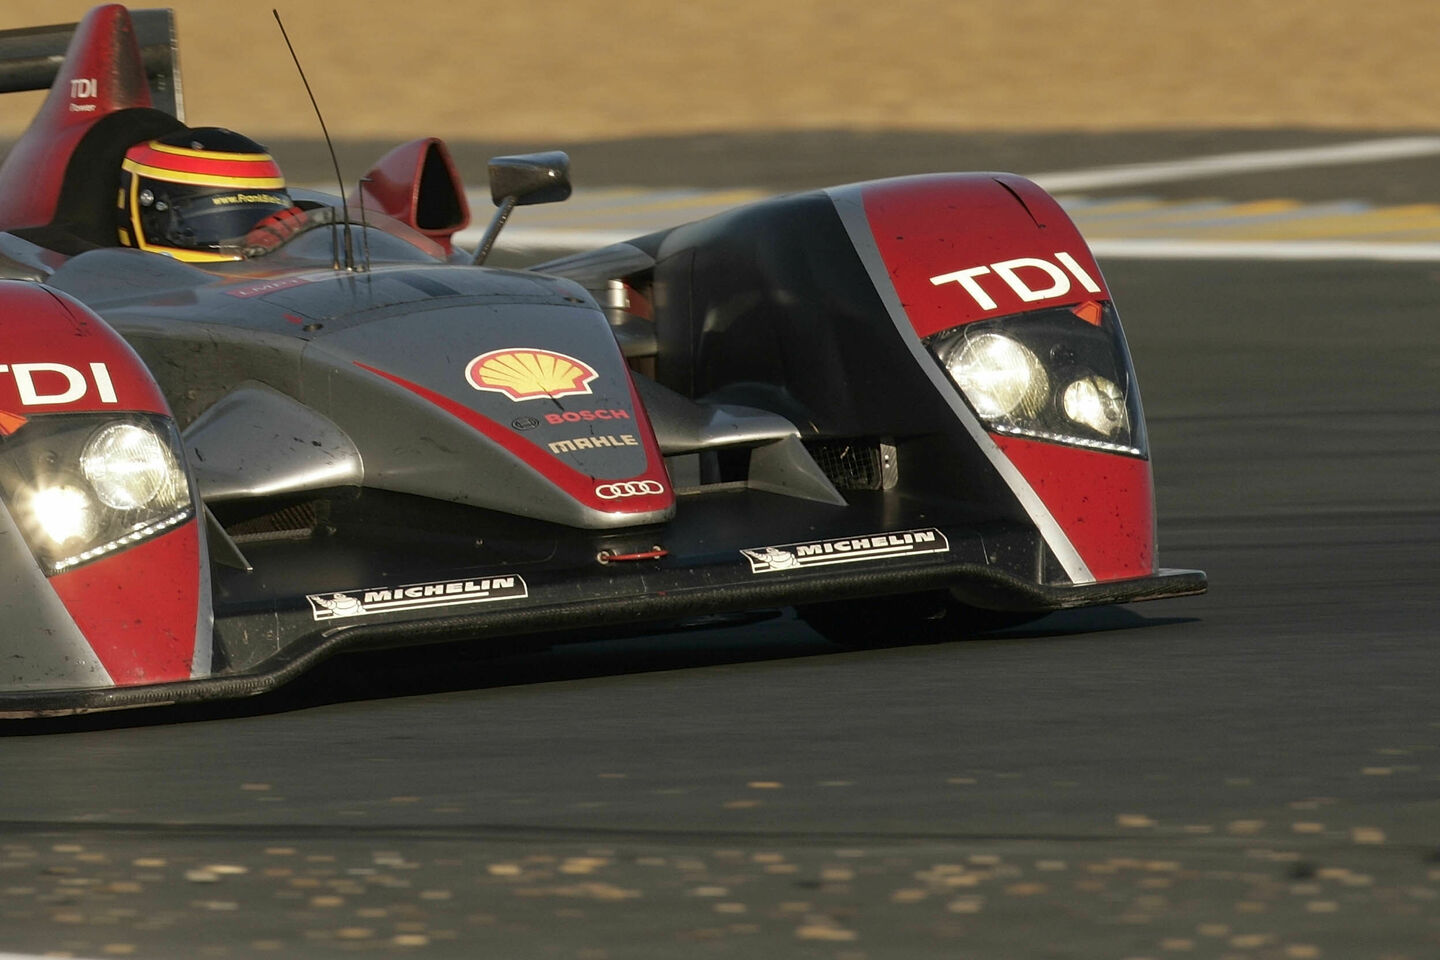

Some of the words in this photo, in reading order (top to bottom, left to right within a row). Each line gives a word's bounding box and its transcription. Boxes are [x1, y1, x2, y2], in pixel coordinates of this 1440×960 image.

[70, 78, 98, 98] TDI
[929, 251, 1102, 311] TDI
[544, 408, 630, 425] BOSCH
[548, 434, 639, 454] MAHLE
[796, 531, 936, 556] MICHELIN
[364, 577, 515, 603] MICHELIN
